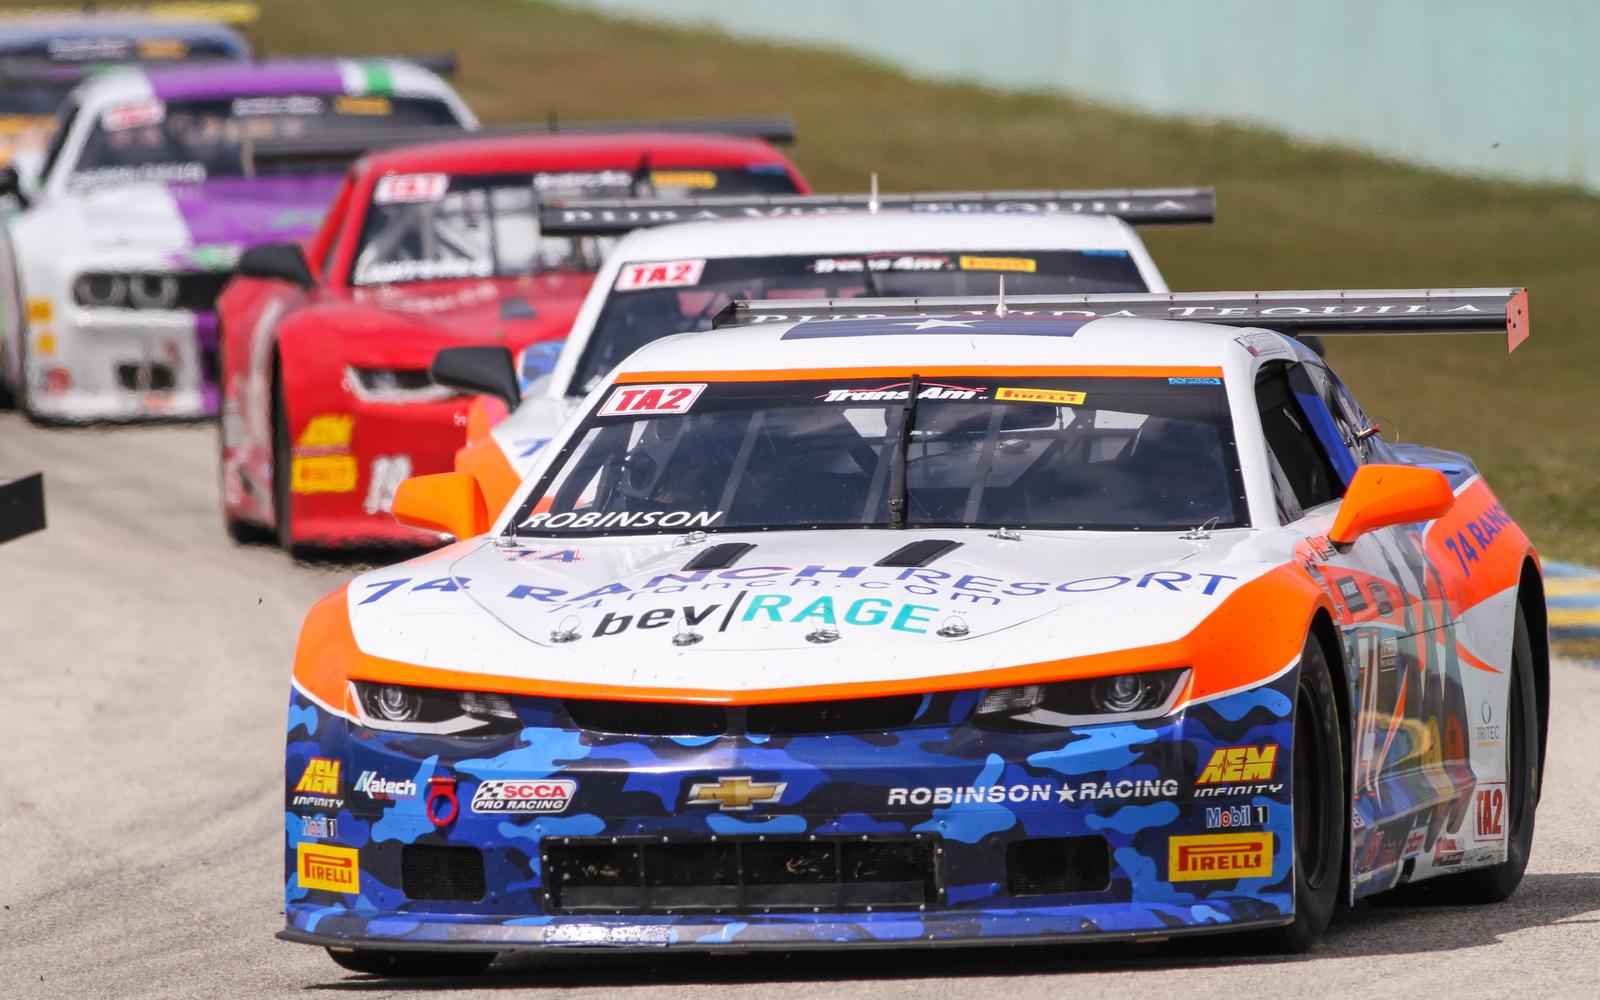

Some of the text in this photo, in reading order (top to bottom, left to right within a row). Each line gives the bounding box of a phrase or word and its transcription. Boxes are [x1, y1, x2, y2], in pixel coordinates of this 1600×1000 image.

[631, 264, 693, 285] TA2
[1168, 304, 1482, 316] TEQUILA
[614, 388, 694, 412] TA2
[916, 386, 976, 400] Am
[517, 511, 723, 529] ROBINSON
[506, 548, 585, 563] 74
[1445, 530, 1479, 577] 74
[357, 565, 1238, 605] 74 RANCH RESORT
[1195, 744, 1278, 785] AEM
[353, 770, 417, 799] Katech
[503, 785, 567, 798] SCCA
[887, 779, 1179, 805] ROBINSON RACING
[1193, 784, 1283, 798] INFINITY
[475, 800, 564, 809] PRO RACING
[1476, 788, 1503, 836] TA2
[1206, 805, 1251, 828] Mobil
[1178, 842, 1264, 871] PIRELLI
[303, 853, 353, 884] PIRELLI
